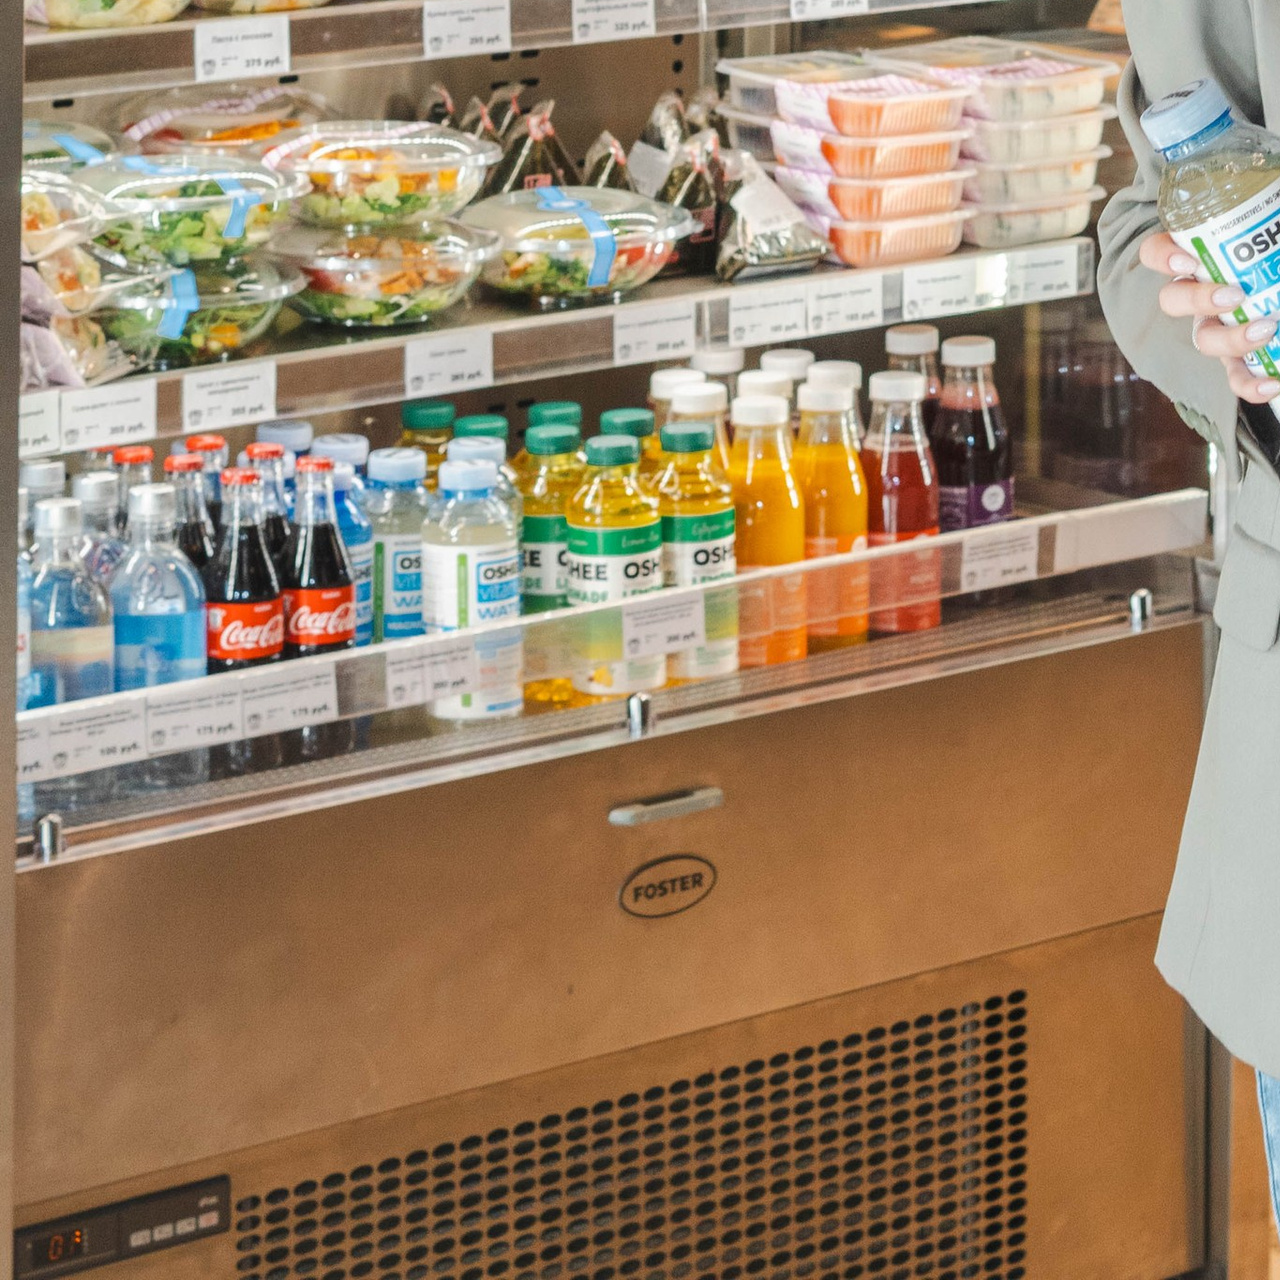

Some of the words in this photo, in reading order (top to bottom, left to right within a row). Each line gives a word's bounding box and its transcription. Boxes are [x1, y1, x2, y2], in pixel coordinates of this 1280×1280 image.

[1219, 203, 1264, 236] PRESERVATIVES
[1265, 194, 1276, 207] NO
[632, 871, 703, 903] FOSTER
